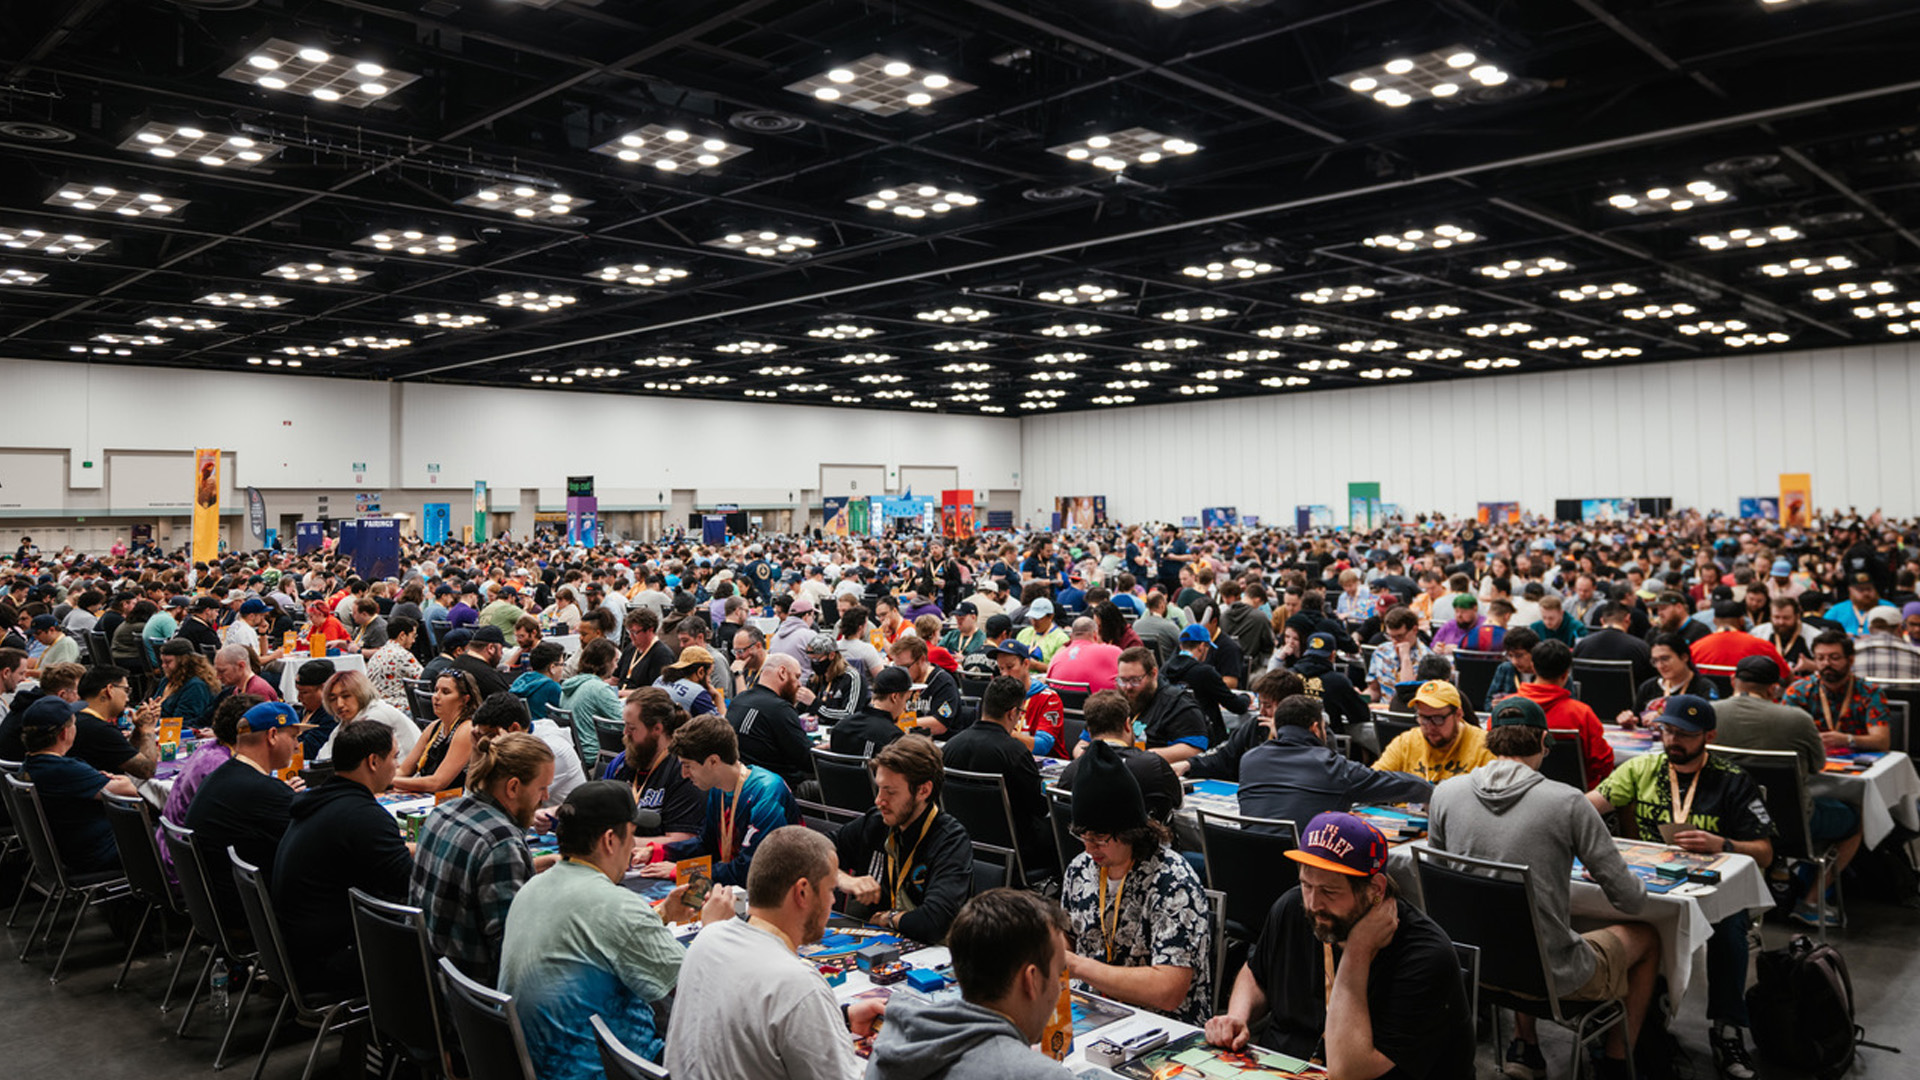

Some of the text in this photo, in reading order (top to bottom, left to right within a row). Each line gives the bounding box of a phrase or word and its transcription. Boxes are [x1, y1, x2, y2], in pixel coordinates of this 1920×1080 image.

[364, 520, 394, 528] PAIRINGS
[1325, 823, 1340, 834] THE
[1308, 830, 1354, 859] VALLEY
